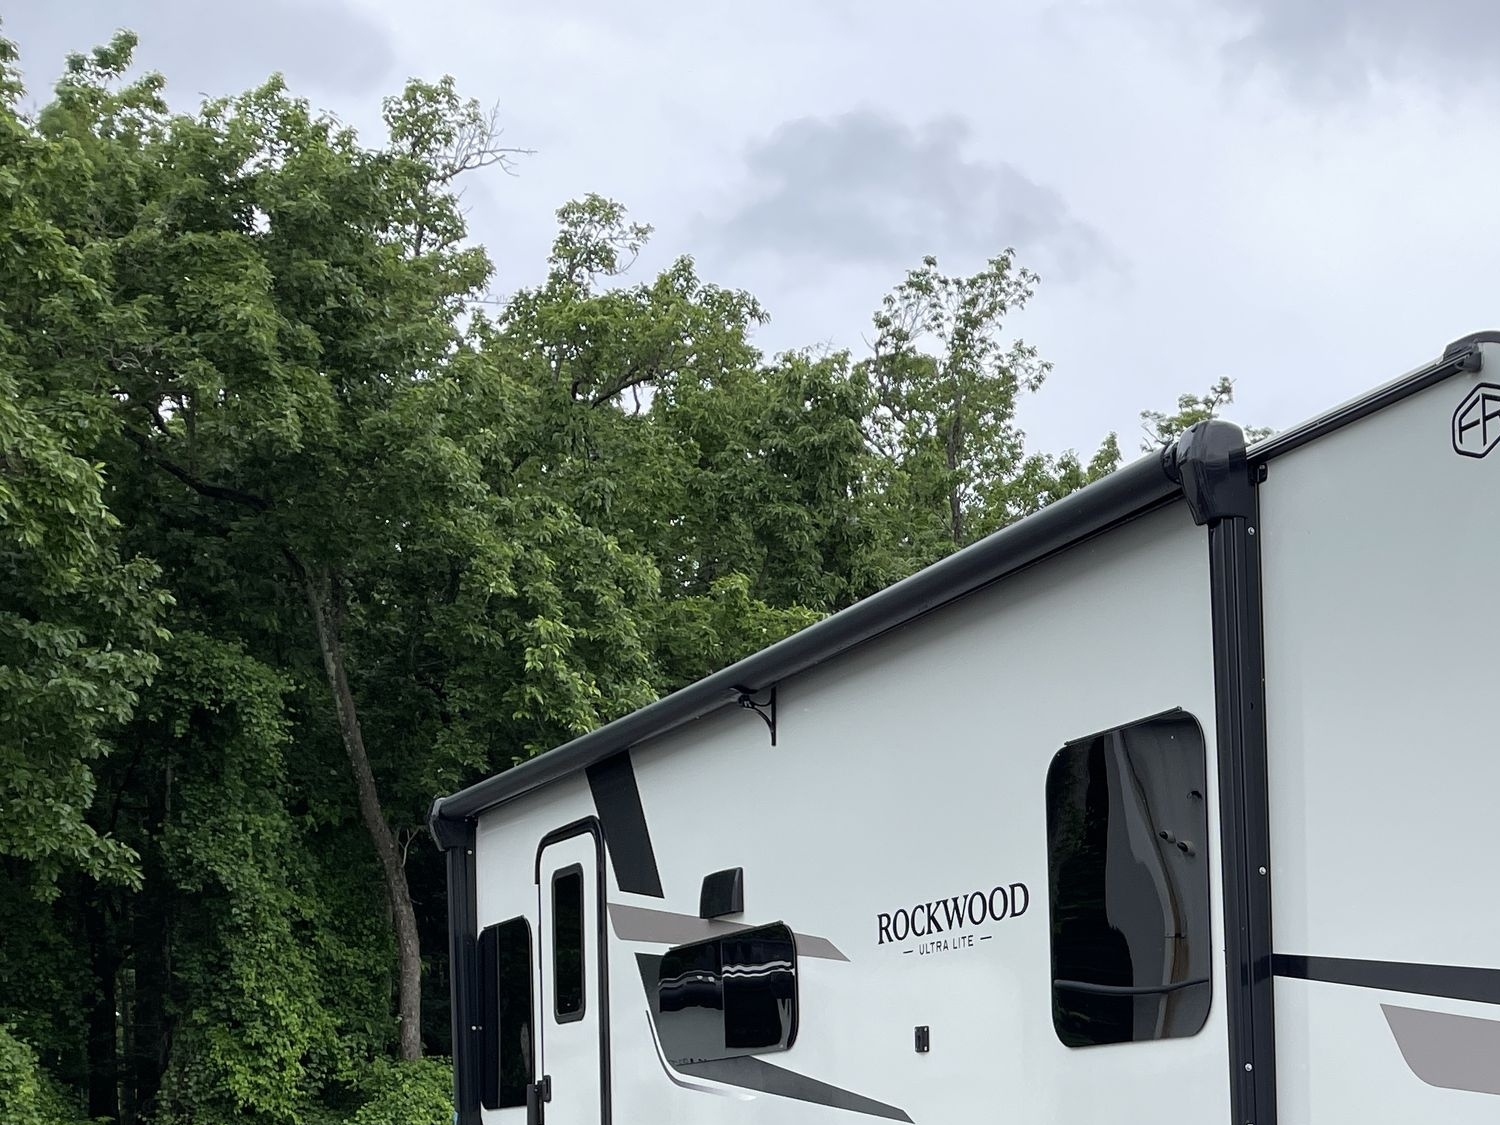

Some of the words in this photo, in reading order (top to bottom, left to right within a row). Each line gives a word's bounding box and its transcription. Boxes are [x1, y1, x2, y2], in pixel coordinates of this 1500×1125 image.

[877, 882, 1030, 945] ROCKWOOD
[919, 939, 949, 955] ULTRA
[952, 934, 974, 950] LITE
